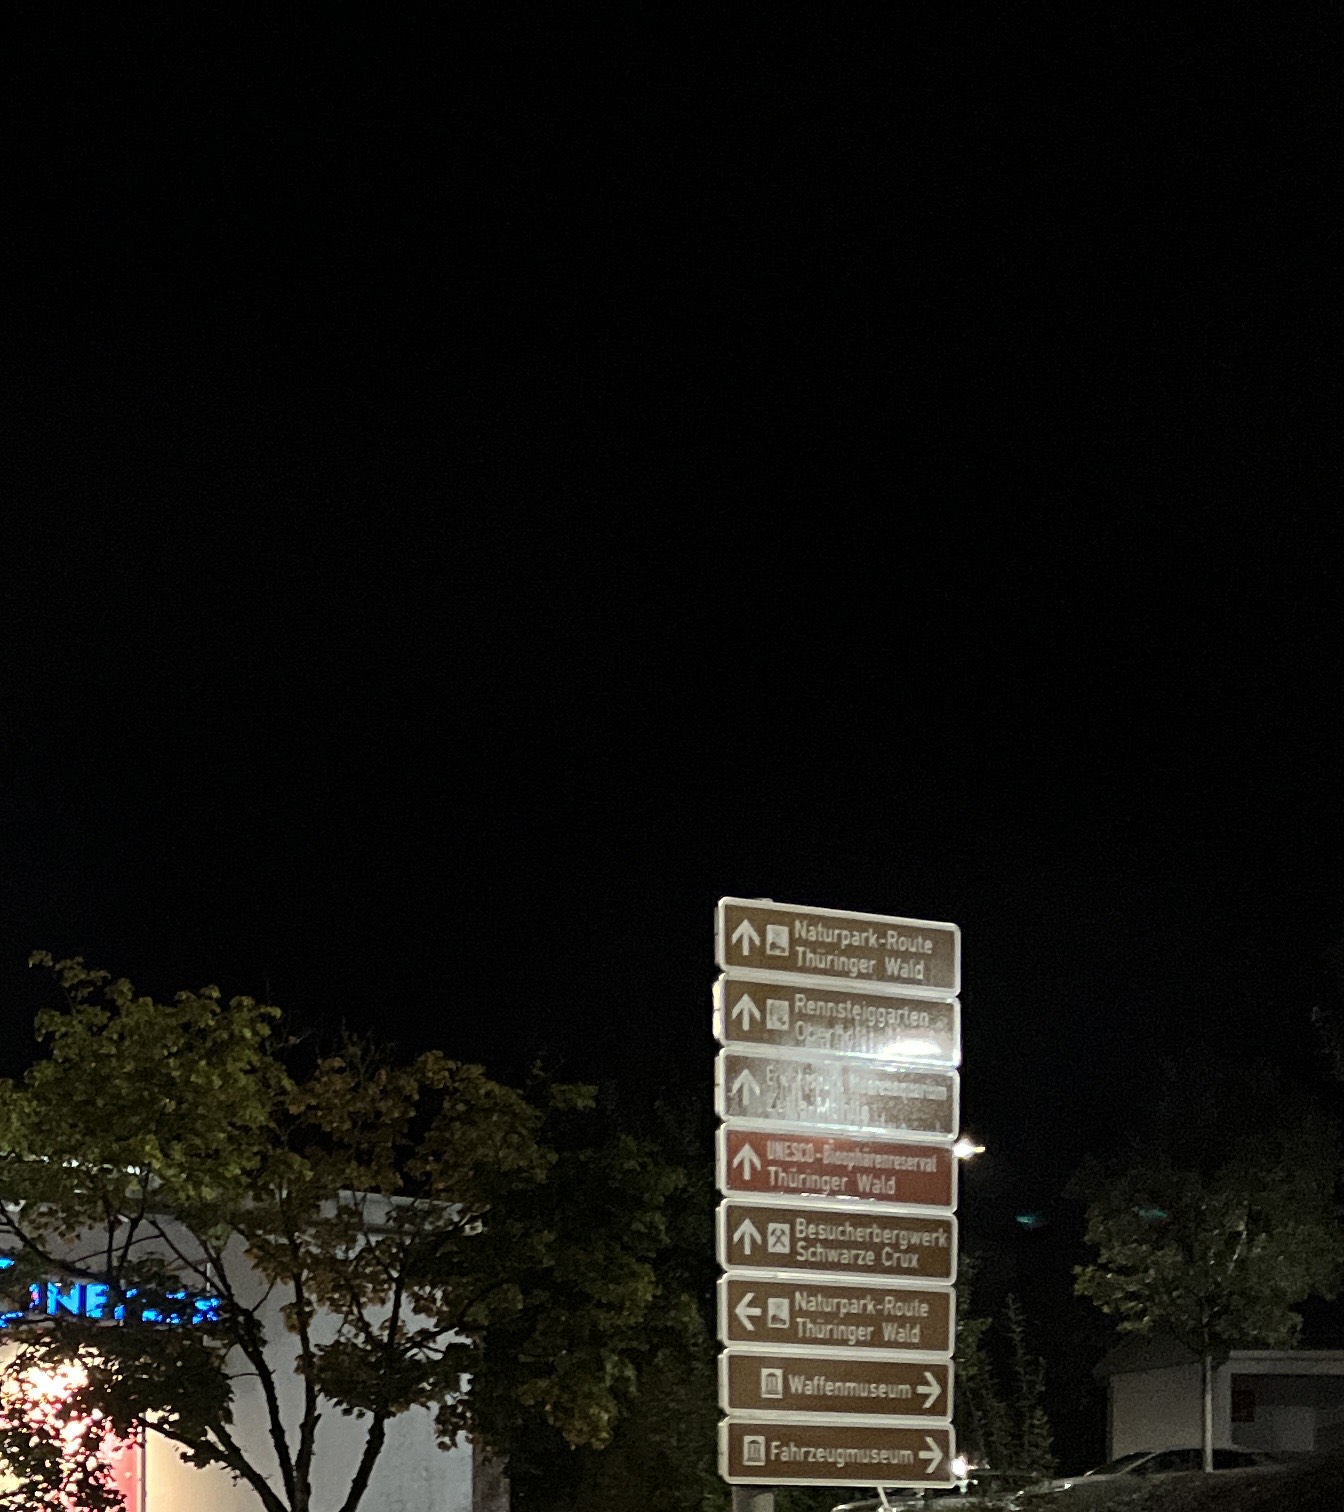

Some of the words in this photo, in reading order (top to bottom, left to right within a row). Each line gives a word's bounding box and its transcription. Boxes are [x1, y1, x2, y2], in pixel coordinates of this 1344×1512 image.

[795, 920, 933, 955] Naturpark-Route
[795, 946, 877, 977] Thüringer
[884, 956, 925, 980] Wald
[795, 994, 929, 1028] Rennsteiggarten
[767, 1166, 848, 1197] Thüringer
[856, 1173, 896, 1194] Wald
[795, 1218, 948, 1249] Besucherbergwerk
[796, 1242, 875, 1265] Schwarze
[882, 1247, 919, 1269] Crux
[795, 1291, 929, 1318] Naturpark-Route
[796, 1318, 874, 1345] Thüringer
[882, 1322, 921, 1343] Wald
[789, 1375, 912, 1398] Waffenmuseum
[771, 1441, 914, 1467] Fahrzeugmuseum
